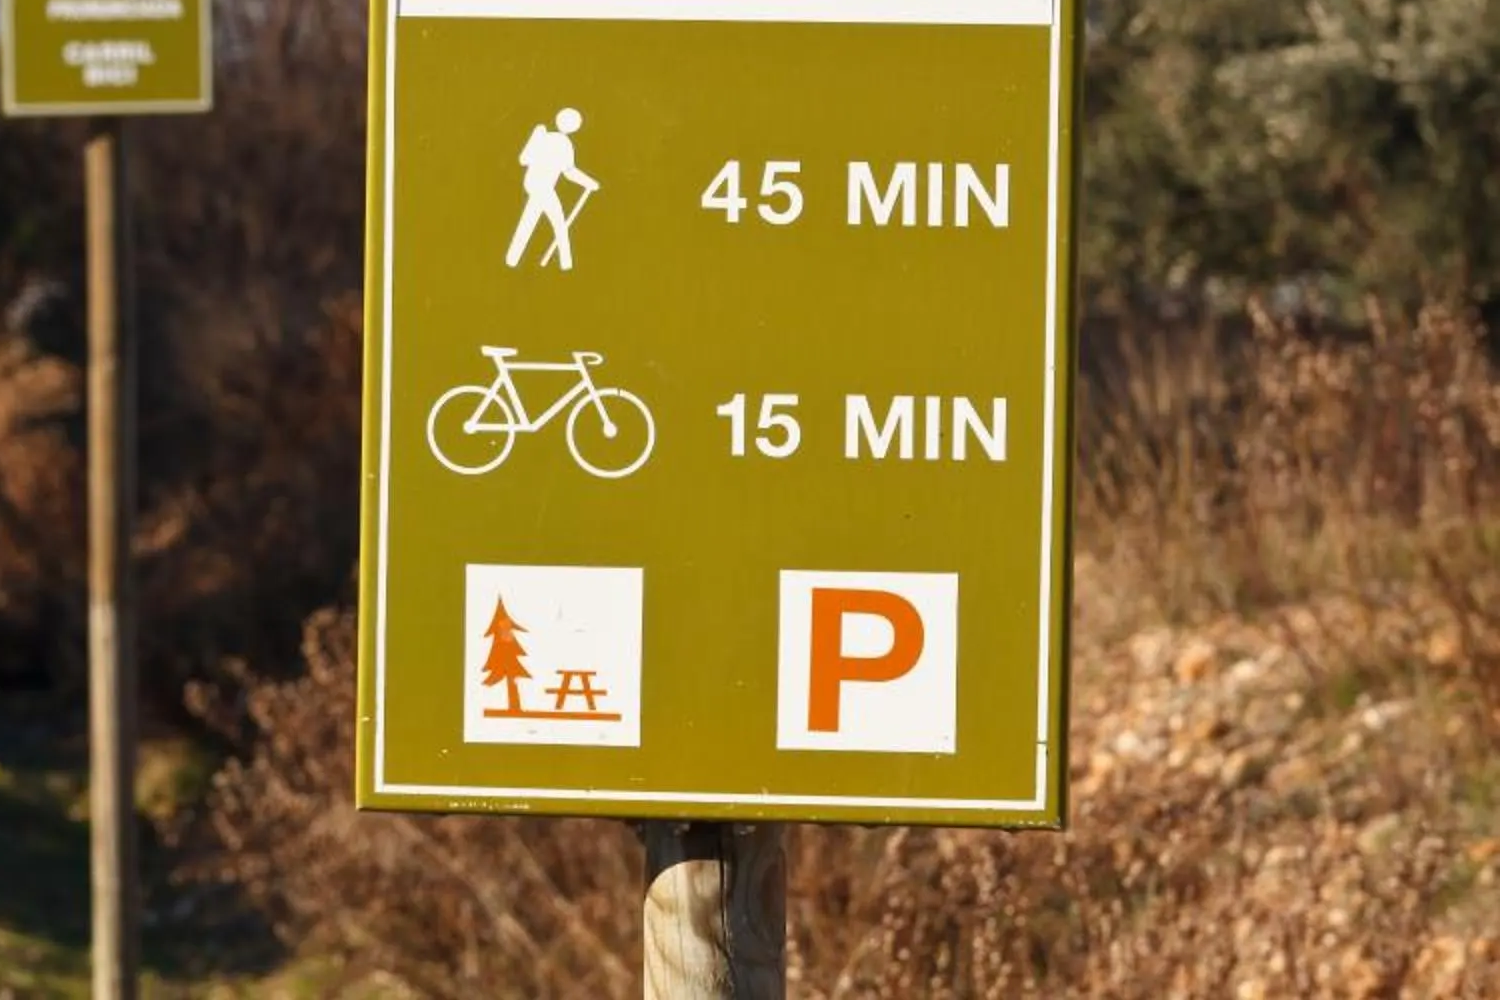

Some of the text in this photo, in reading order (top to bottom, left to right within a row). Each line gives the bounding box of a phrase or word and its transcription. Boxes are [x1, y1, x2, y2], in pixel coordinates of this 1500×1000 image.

[700, 159, 1011, 228] 45 MIN
[715, 392, 1008, 462] 15 MIN
[806, 586, 926, 735] P
